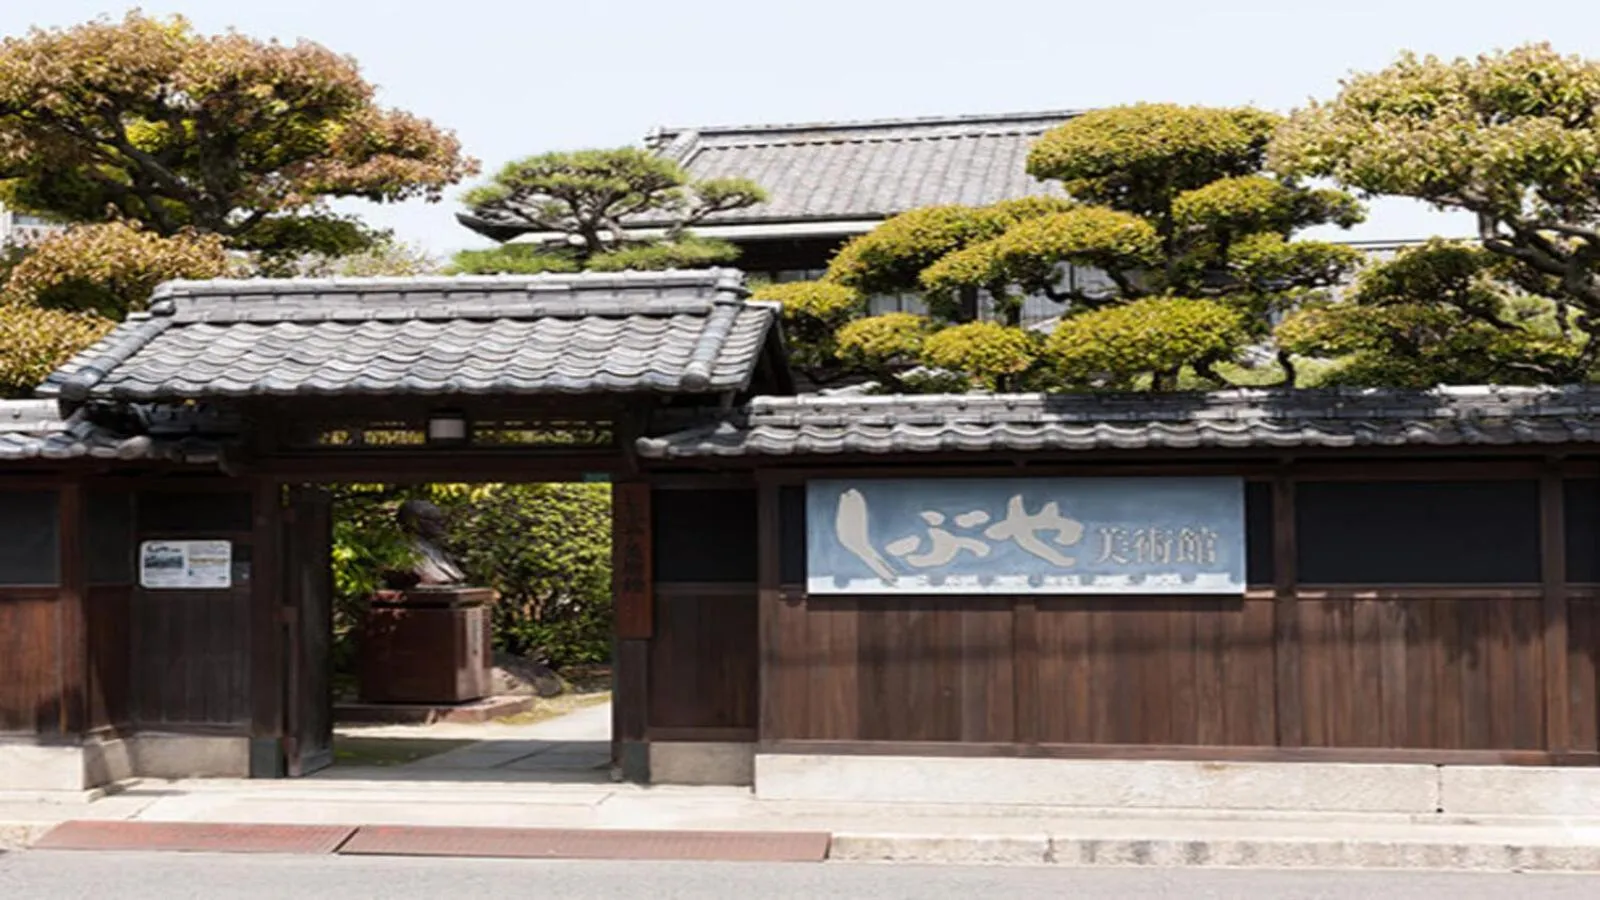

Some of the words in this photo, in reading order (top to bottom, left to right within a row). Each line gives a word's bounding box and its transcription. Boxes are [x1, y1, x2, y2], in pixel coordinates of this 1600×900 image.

[836, 488, 1084, 587] しぶや
[1097, 527, 1218, 564] 美術館
